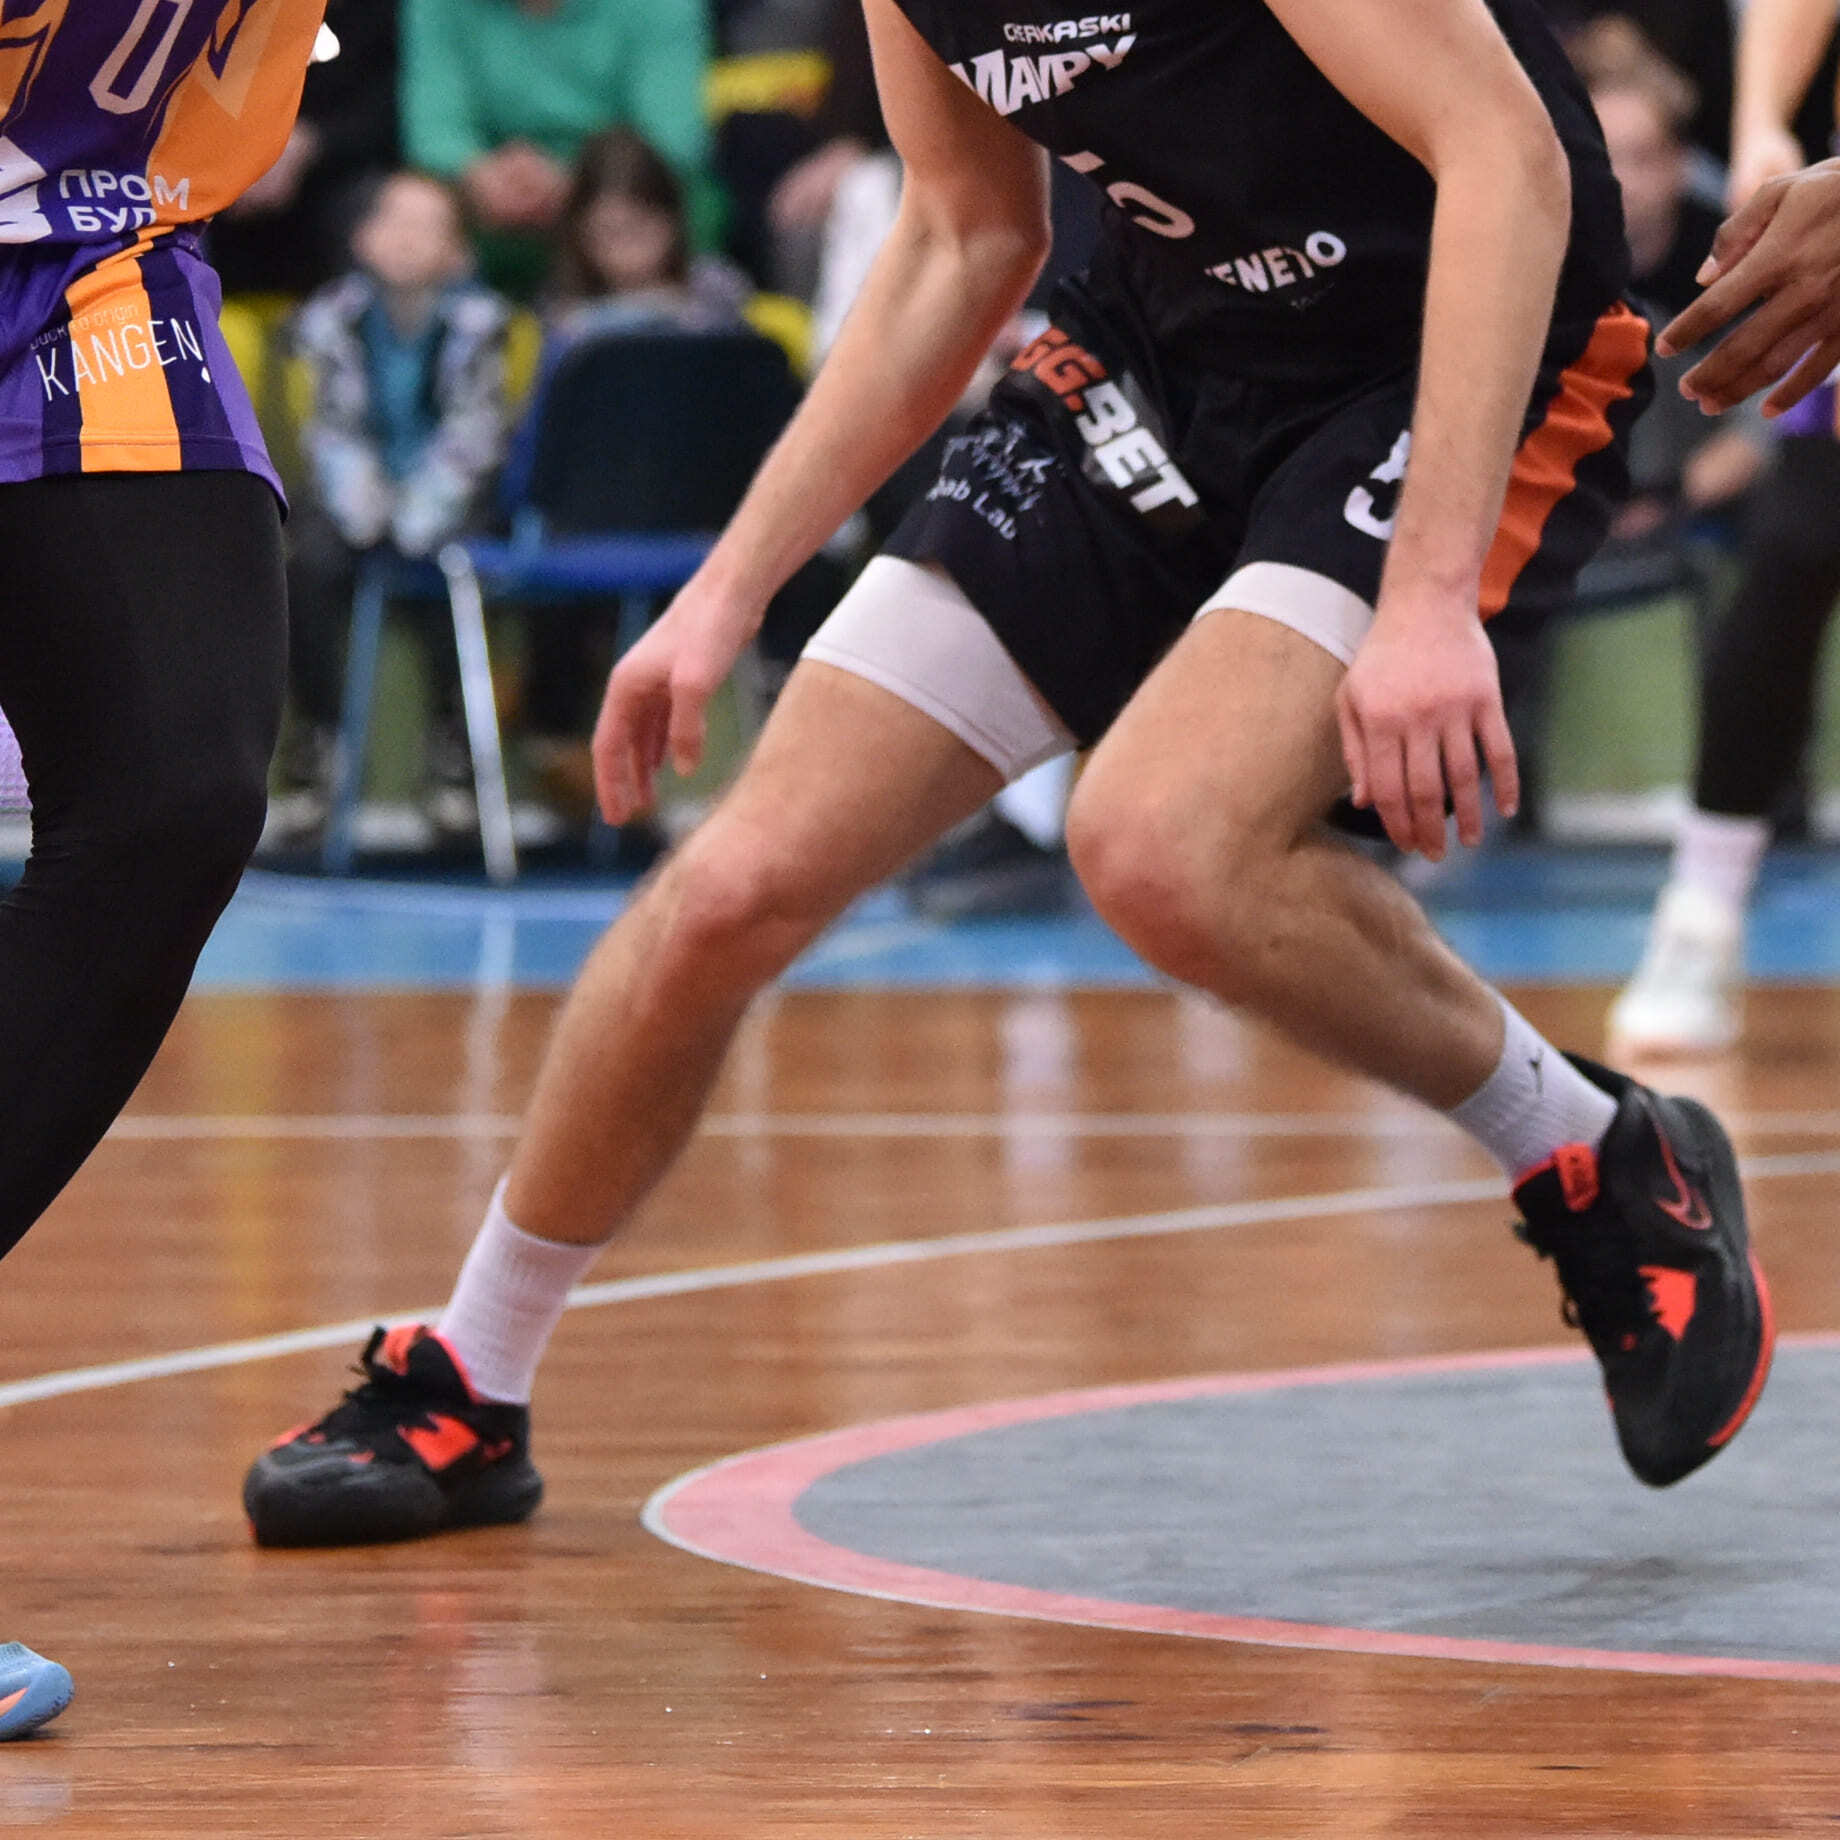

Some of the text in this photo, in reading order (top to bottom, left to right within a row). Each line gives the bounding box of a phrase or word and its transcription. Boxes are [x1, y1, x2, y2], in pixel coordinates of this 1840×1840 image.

[59, 168, 190, 211] ПРОМ
[1204, 230, 1348, 293] ENETO
[35, 317, 205, 401] KANGEN
